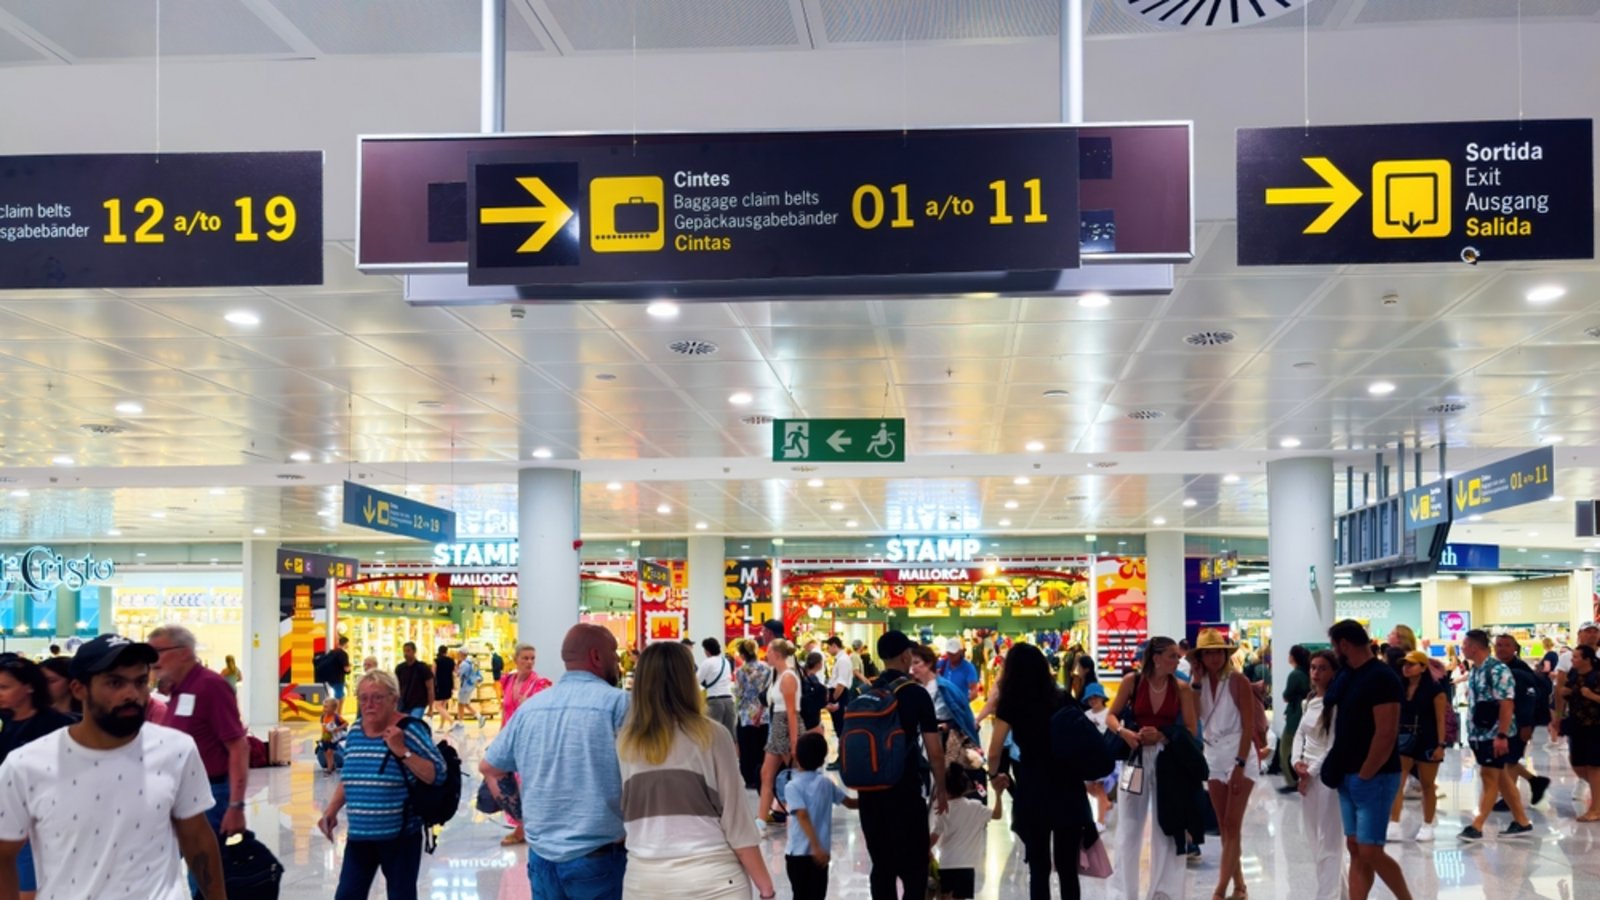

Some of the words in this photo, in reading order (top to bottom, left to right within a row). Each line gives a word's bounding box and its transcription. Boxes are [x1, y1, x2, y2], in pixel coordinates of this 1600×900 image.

[1466, 142, 1543, 161] Sortida
[674, 171, 730, 188] Cintes
[1466, 167, 1501, 187] Exit
[38, 203, 72, 218] belts
[674, 194, 738, 213] Baggage
[742, 192, 780, 208] claim
[784, 190, 820, 207] belts
[852, 184, 914, 228] 01
[926, 195, 974, 220] a/to
[989, 178, 1048, 225] 11
[1465, 192, 1549, 214] Ausgang
[103, 197, 165, 243] 12
[173, 210, 222, 235] a/to
[234, 195, 297, 242] 19
[674, 209, 839, 233] Gepäckausgabebänder
[1466, 217, 1532, 237] Salida
[0, 223, 91, 242] sgabebänder
[674, 234, 732, 252] Cintas
[1510, 472, 1523, 490] 01
[1535, 464, 1549, 484] 11
[413, 514, 424, 529] 12
[430, 518, 440, 533] 19
[886, 538, 981, 561] STAMP
[21, 545, 115, 592] Cristo
[898, 568, 969, 581] MALLORCA
[450, 573, 519, 587] MALLORCA
